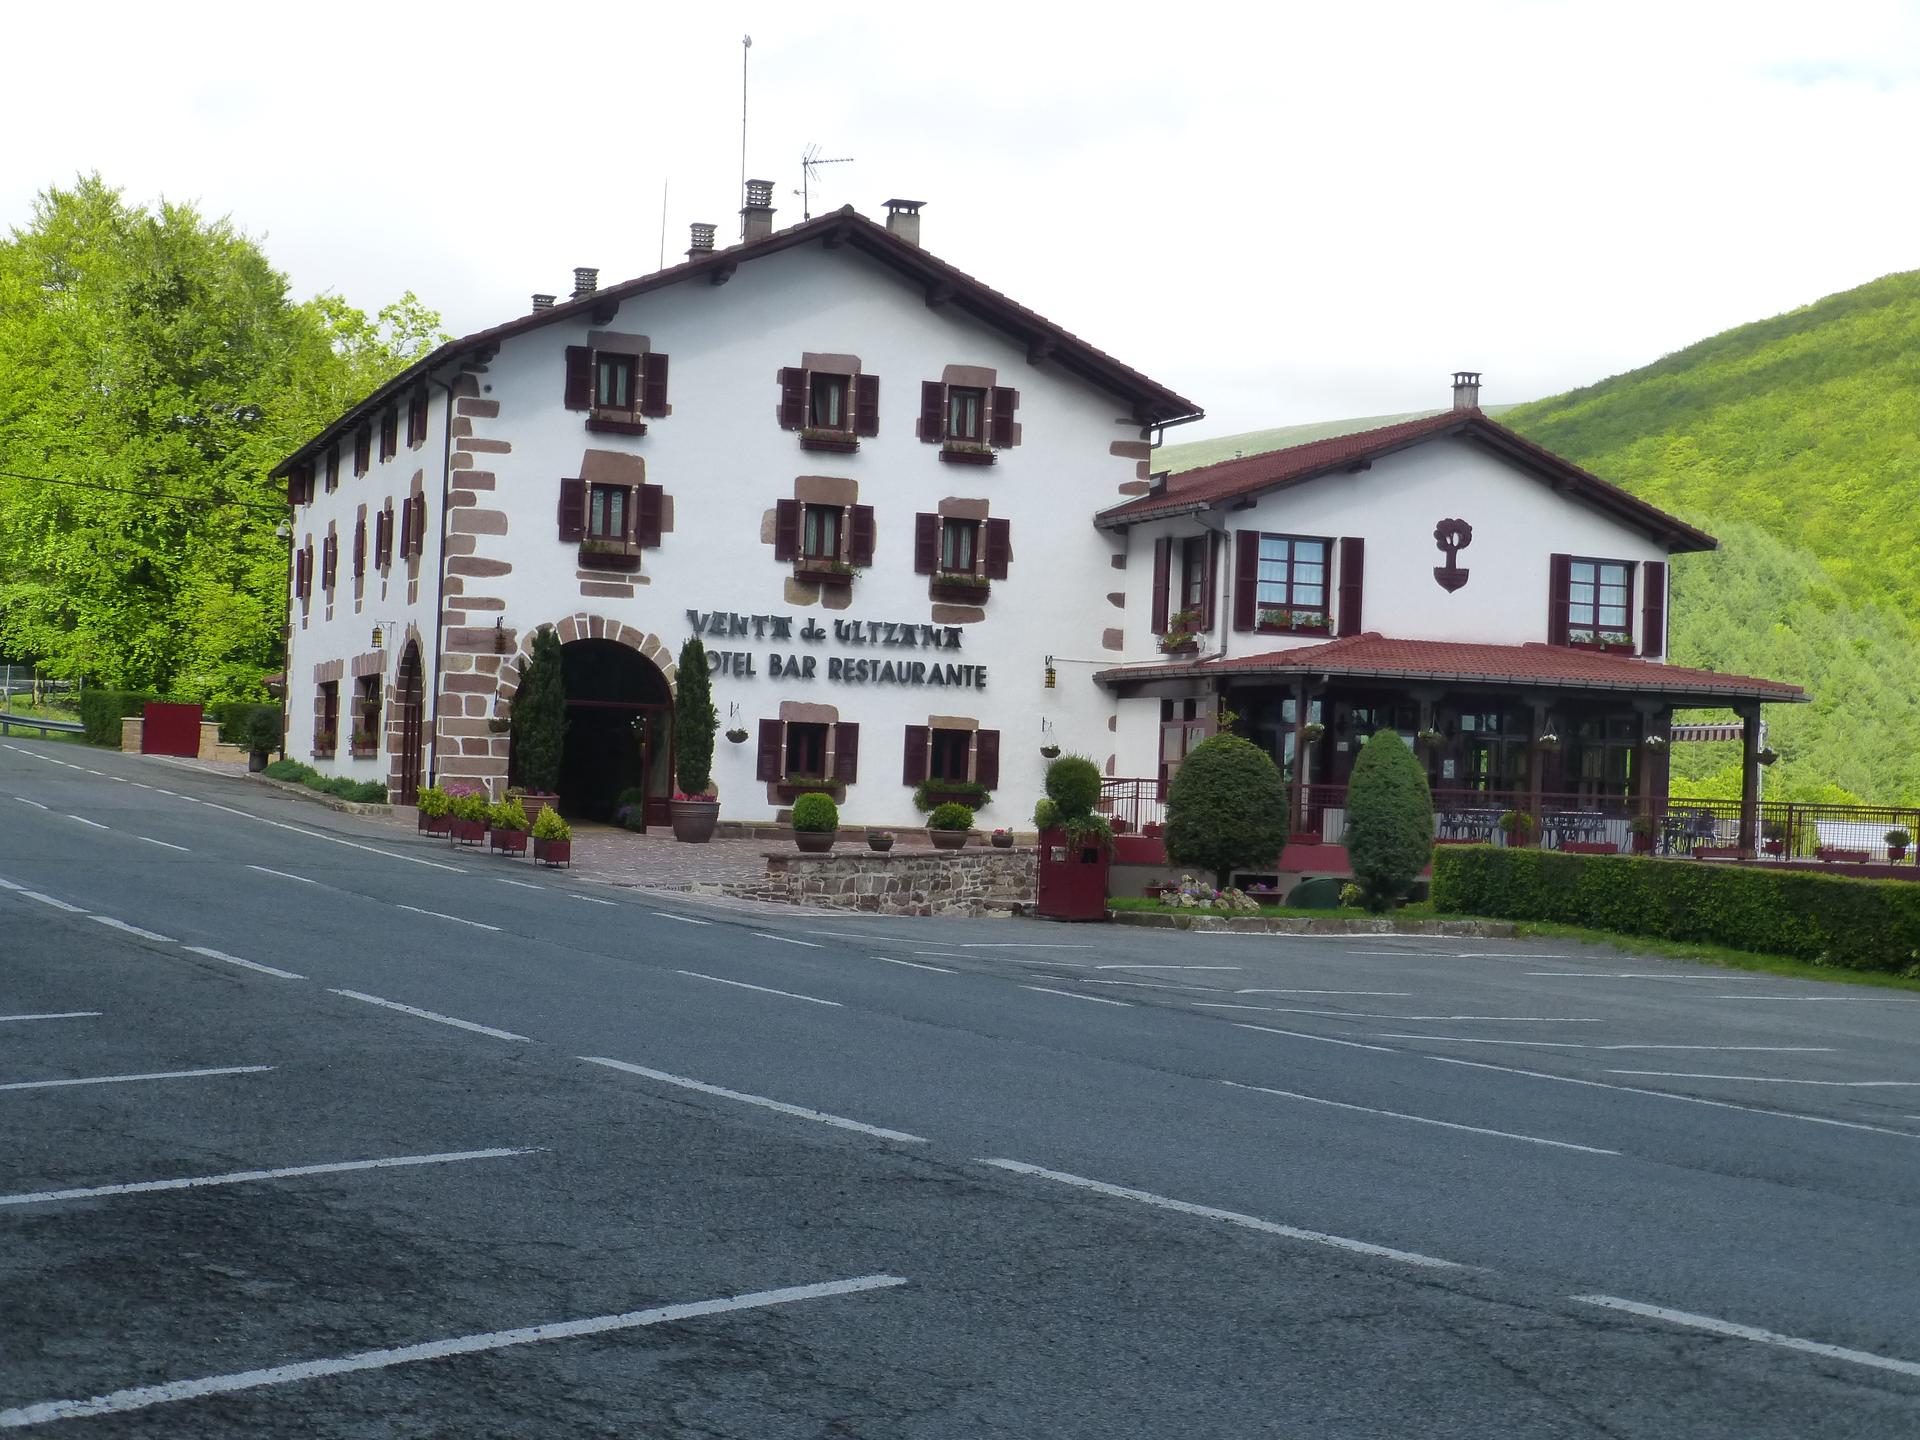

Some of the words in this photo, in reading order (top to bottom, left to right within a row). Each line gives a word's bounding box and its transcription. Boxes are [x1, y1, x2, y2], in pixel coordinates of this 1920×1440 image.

[687, 609, 793, 638] VENTA
[800, 617, 827, 640] de
[834, 618, 964, 648] ULTZAMA
[705, 650, 757, 676] OTEL
[769, 653, 817, 679] BAR
[828, 656, 988, 688] RESTAURANTE
